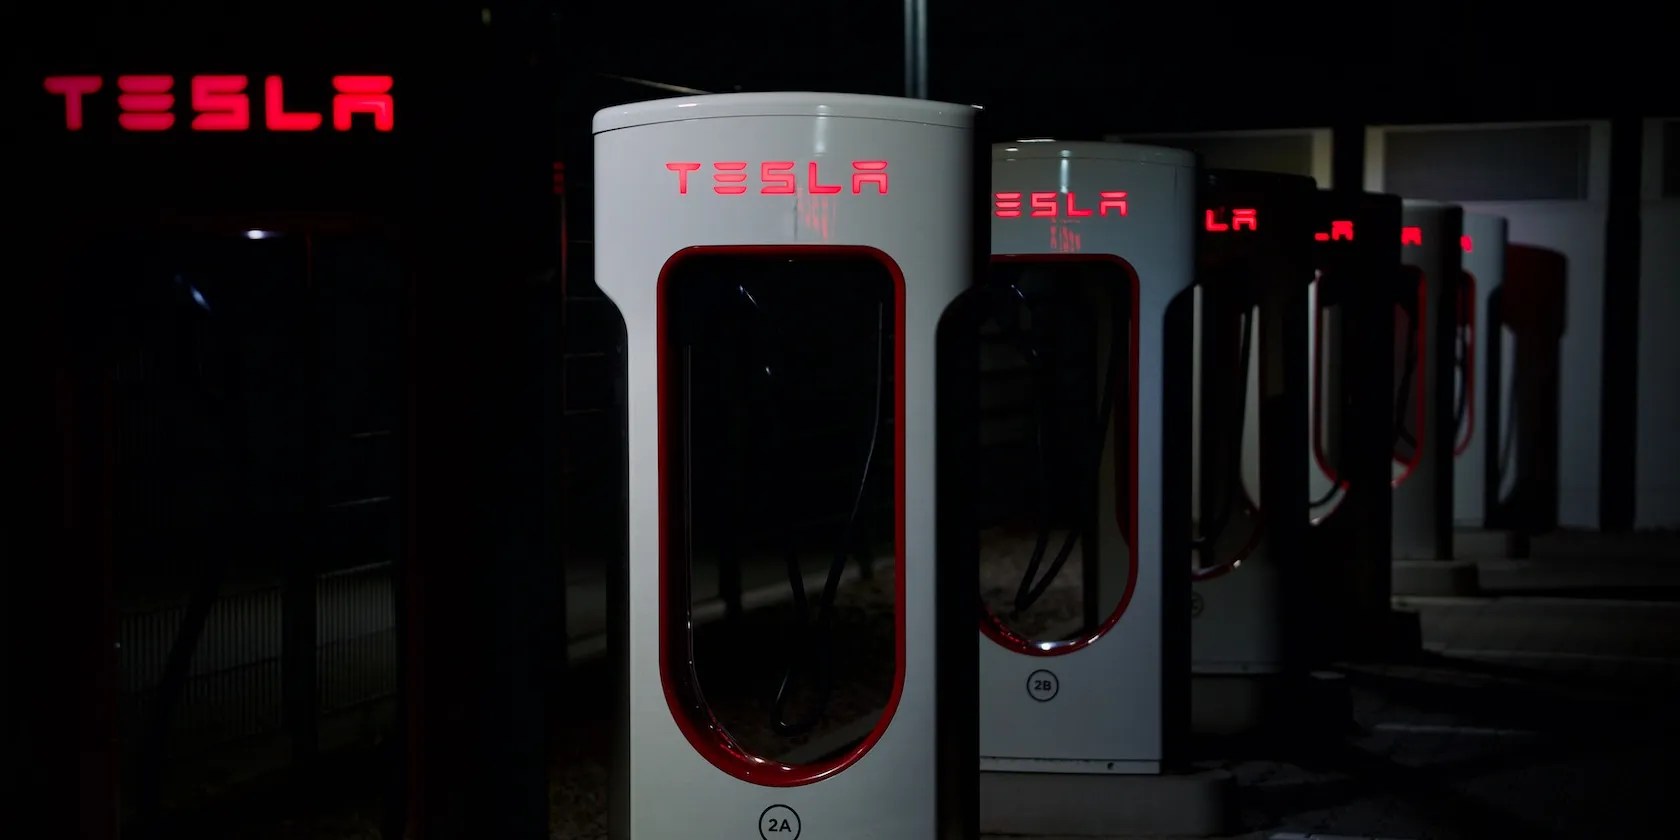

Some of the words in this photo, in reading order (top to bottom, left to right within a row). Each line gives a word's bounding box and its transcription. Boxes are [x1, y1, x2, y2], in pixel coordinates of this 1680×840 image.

[45, 74, 394, 132] TESLA
[665, 161, 889, 196] TESLA
[1034, 680, 1052, 691] 2B
[768, 818, 792, 833] 2A
